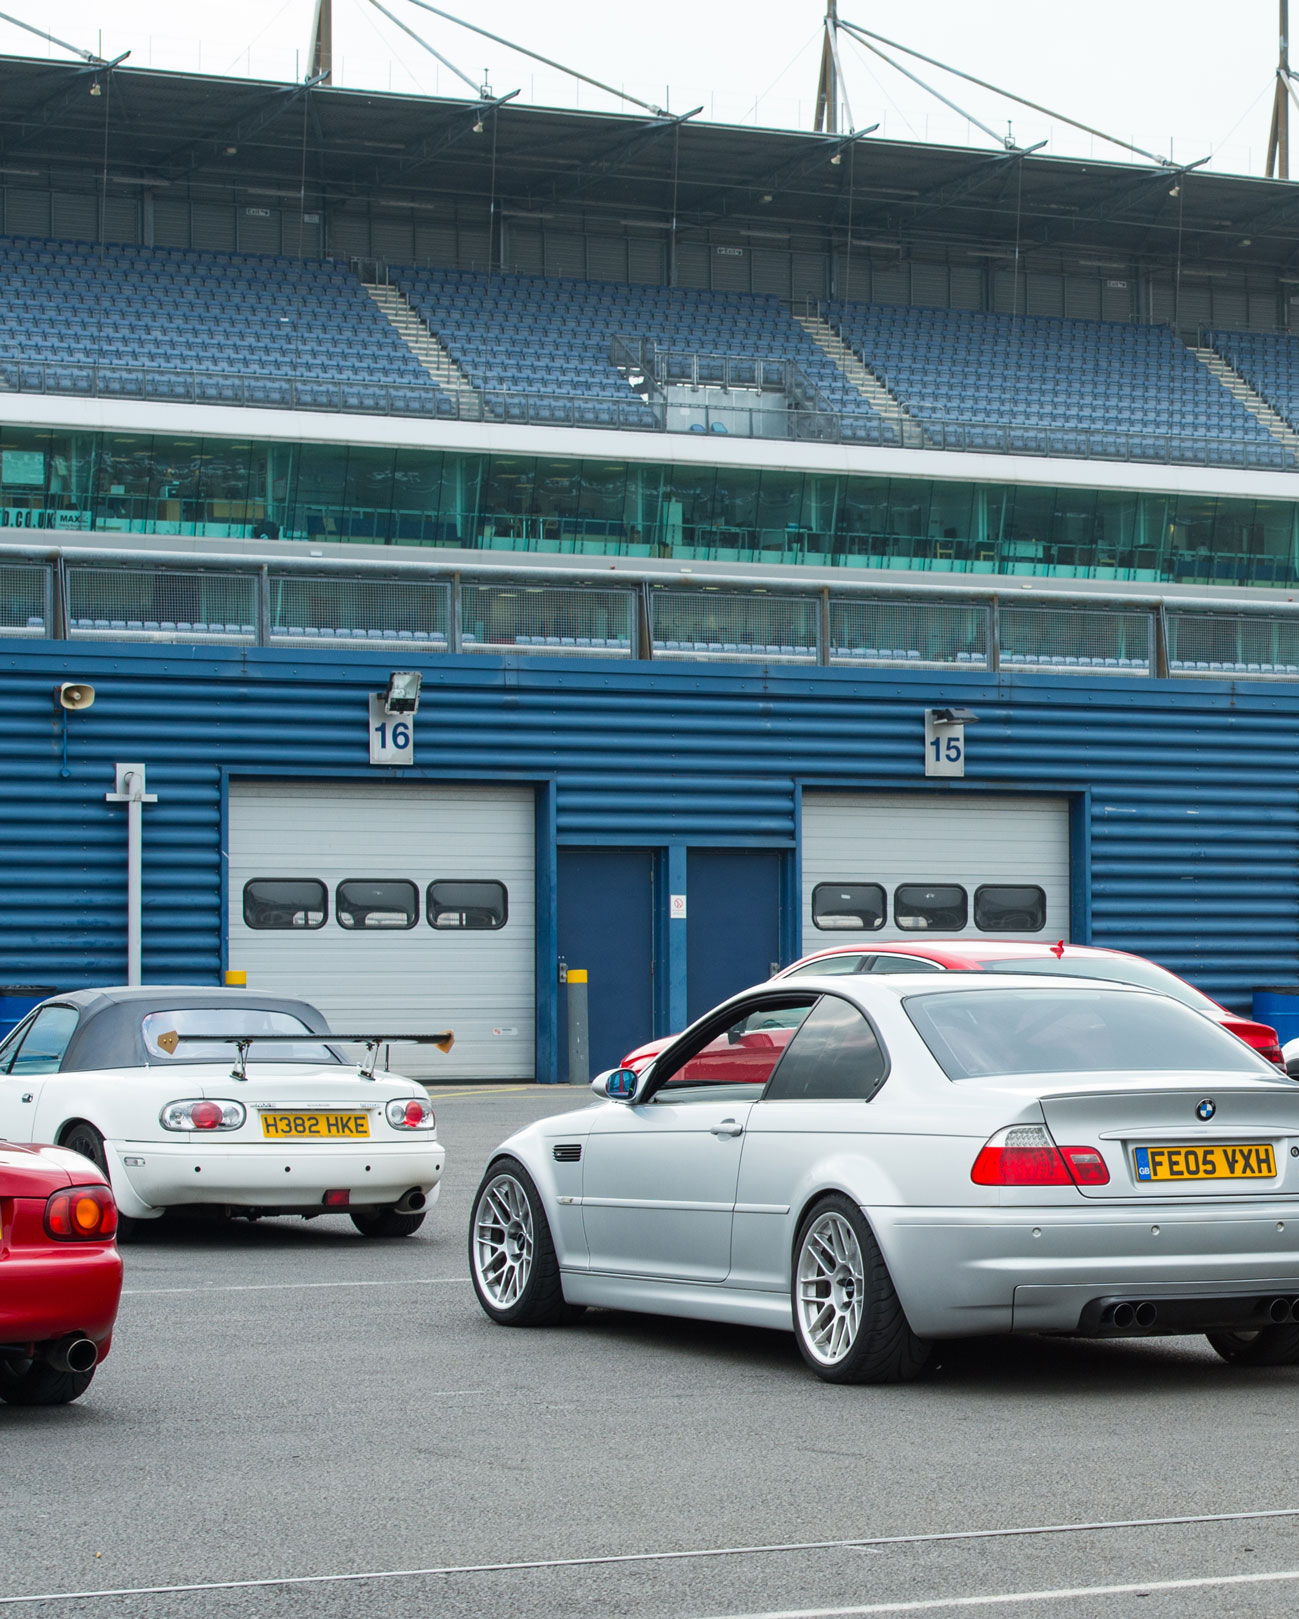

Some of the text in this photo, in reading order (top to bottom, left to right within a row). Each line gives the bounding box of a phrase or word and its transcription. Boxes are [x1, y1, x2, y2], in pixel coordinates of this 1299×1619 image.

[0, 510, 54, 529] D.CO.UK
[60, 515, 80, 523] MAX
[375, 722, 410, 749] 16
[930, 737, 961, 762] 15
[264, 1116, 368, 1133] H382 HKE
[1139, 1167, 1150, 1175] GB
[1150, 1148, 1272, 1176] FE05 VXH
